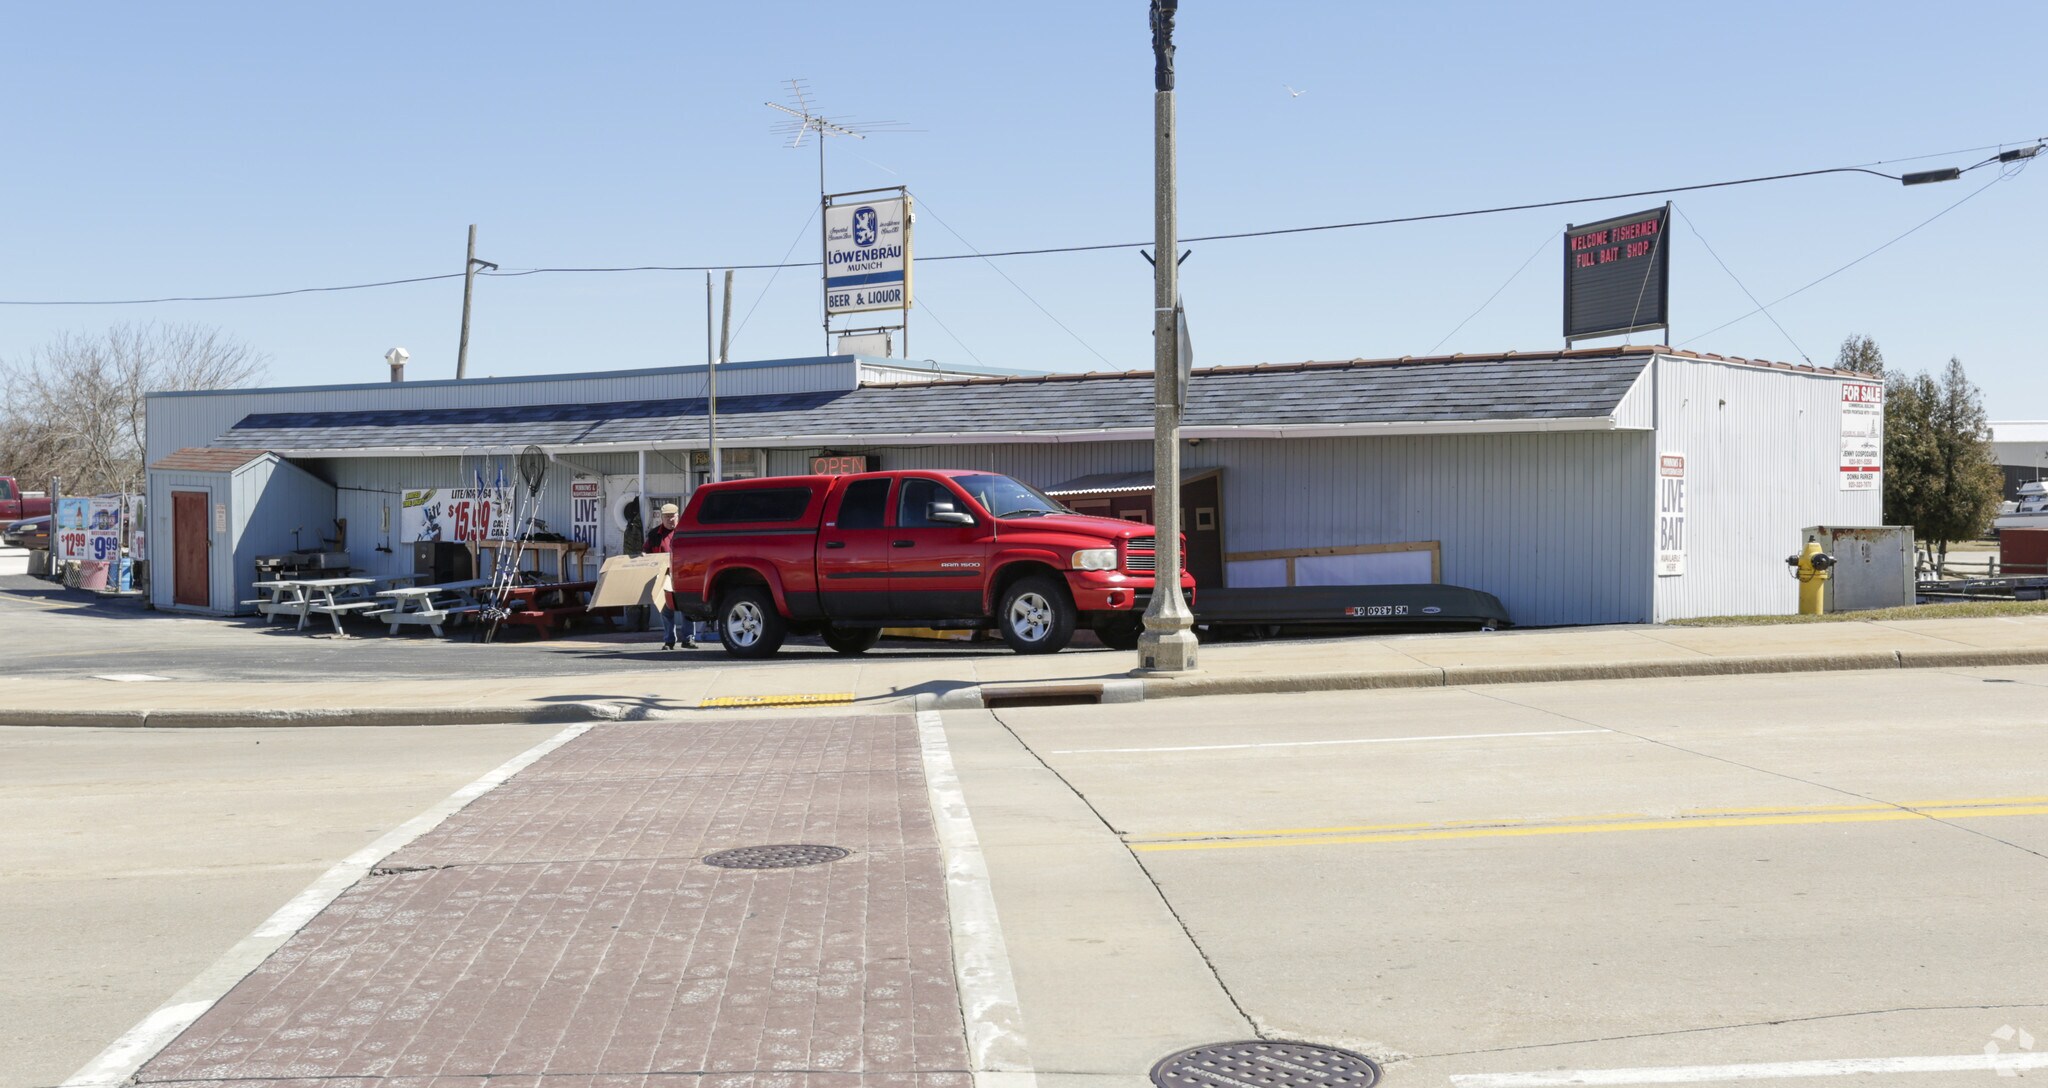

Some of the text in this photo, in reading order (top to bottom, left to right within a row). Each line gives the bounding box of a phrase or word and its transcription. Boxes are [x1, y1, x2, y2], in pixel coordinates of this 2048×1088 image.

[1571, 218, 1658, 251] WELCOME FISHERMEN
[828, 243, 902, 265] LÖWENBRÄU
[1576, 240, 1650, 268] FULL BAIT SHOP
[847, 261, 883, 272] MUNICH
[829, 288, 902, 308] BEER & LIQUOR
[1842, 384, 1881, 402] FOR SALE
[814, 457, 864, 475] OPEN
[1662, 478, 1684, 512] LIVE
[575, 499, 597, 522] LIVE
[574, 525, 597, 548] BAIT
[1661, 517, 1684, 551] BAIT
[1367, 607, 1392, 615] 4360
[1394, 606, 1408, 614] WS
